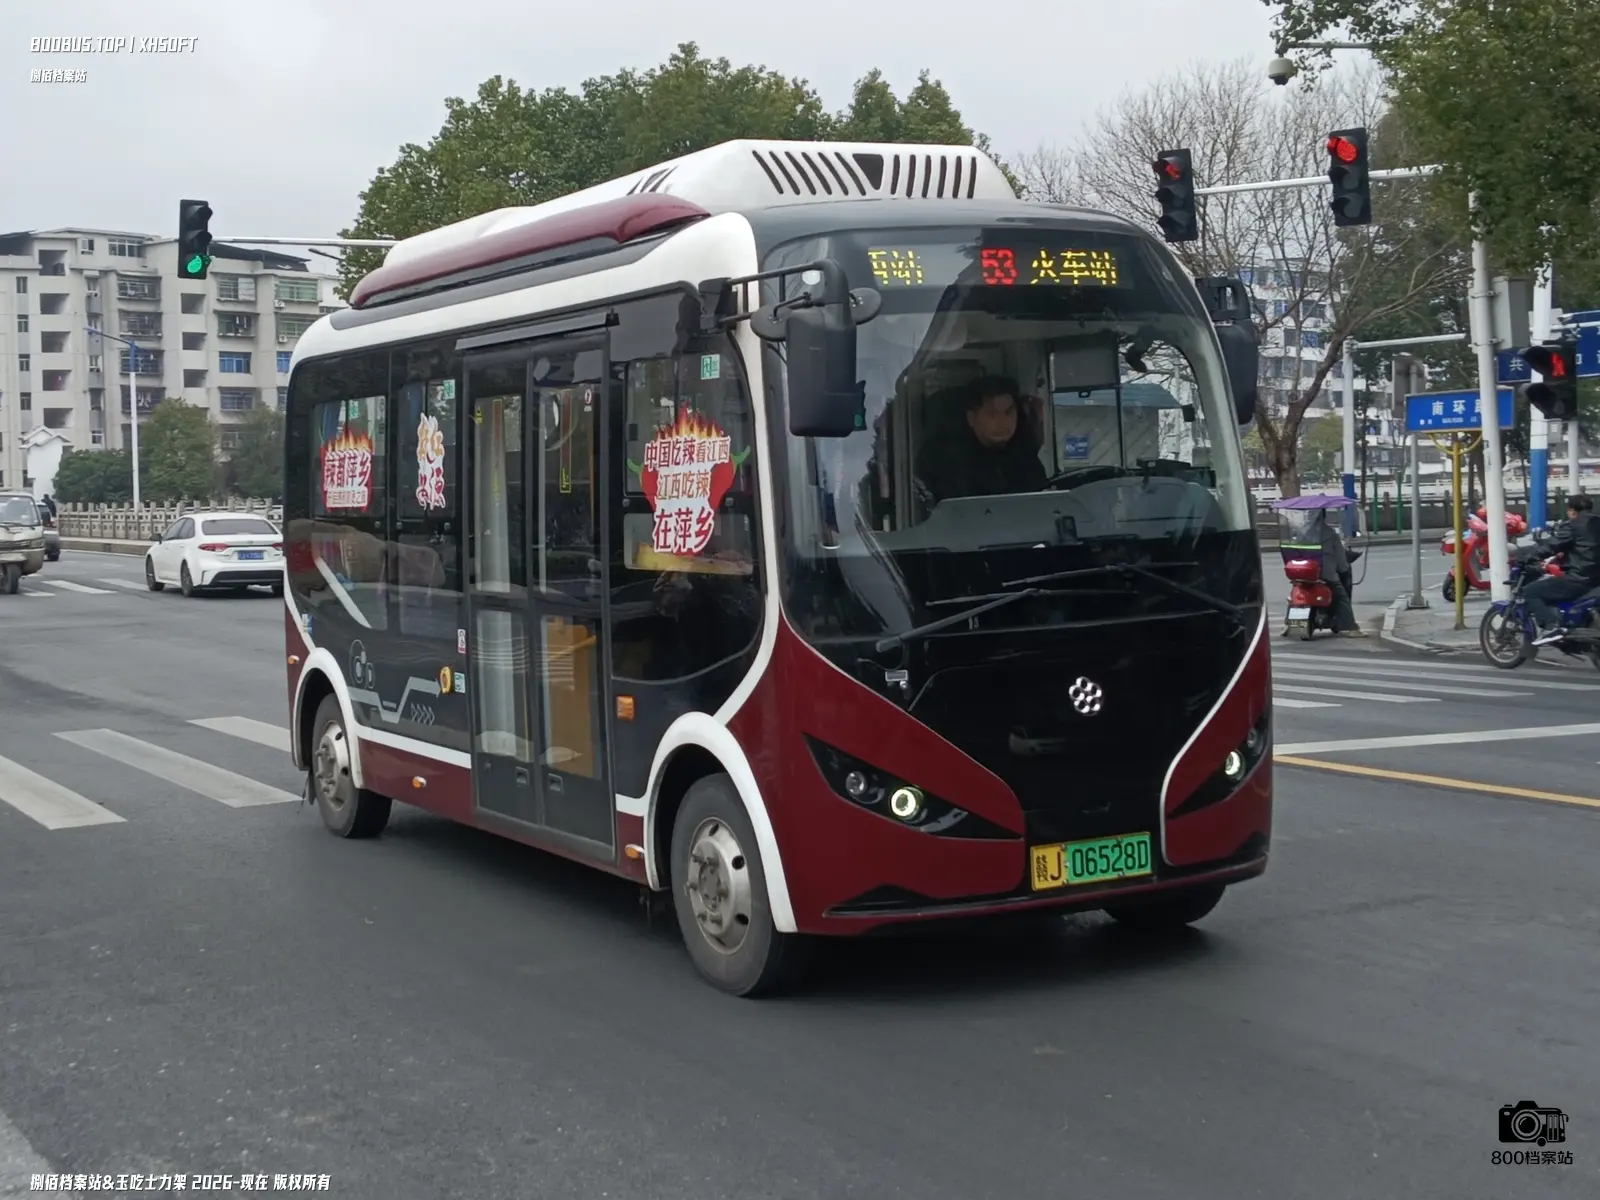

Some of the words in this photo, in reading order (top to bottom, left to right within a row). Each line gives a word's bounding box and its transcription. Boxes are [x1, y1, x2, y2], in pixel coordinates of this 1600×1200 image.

[980, 248, 1018, 286] 53
[1030, 247, 1117, 285] 火车站
[645, 437, 730, 470] 中国吃辣看江西
[657, 471, 711, 500] 江西吃辣
[654, 506, 714, 552] 在萍乡
